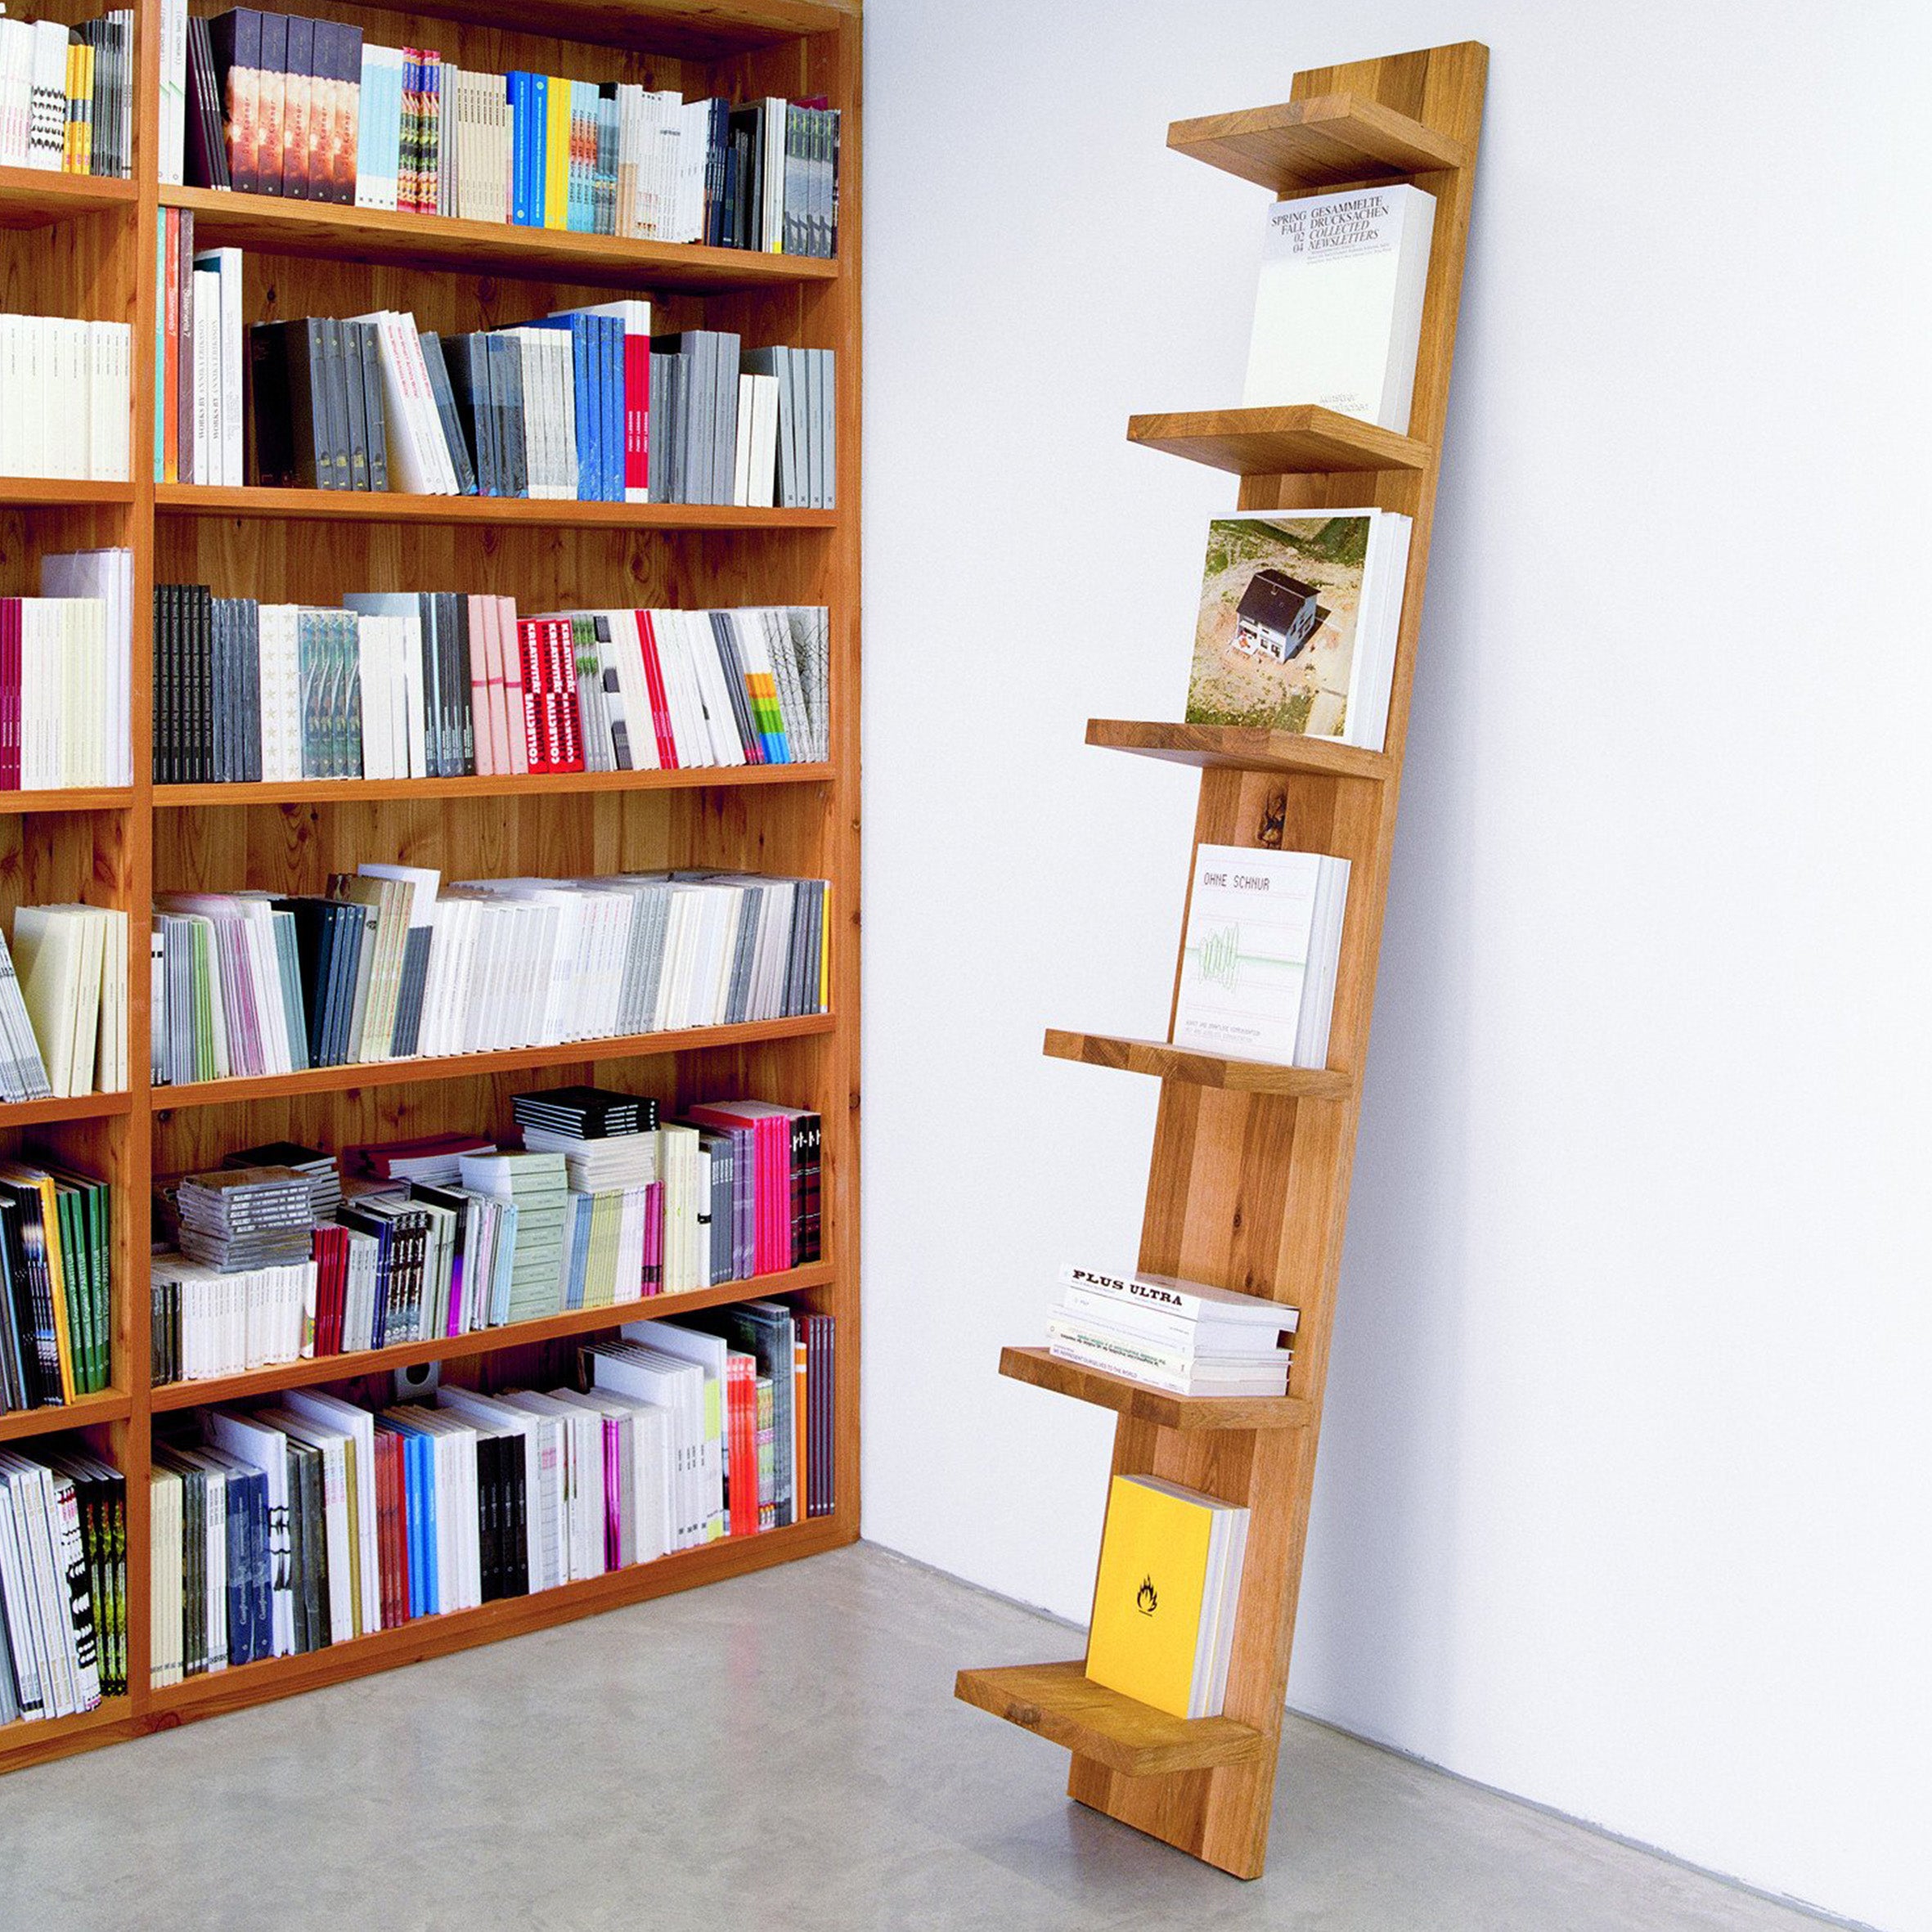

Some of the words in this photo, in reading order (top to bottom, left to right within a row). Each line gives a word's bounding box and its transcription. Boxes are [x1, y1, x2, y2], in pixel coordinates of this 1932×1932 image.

[1272, 211, 1306, 226] SPRING
[1311, 195, 1382, 218] GESAMMELTE
[1282, 221, 1305, 235] FALL
[1310, 206, 1390, 228] DRUCKSACHEN
[1293, 244, 1303, 253] 04
[1309, 229, 1379, 250] NEWSLETTERS
[1294, 231, 1305, 242] 02
[1310, 221, 1369, 240] COLLECTED
[528, 623, 541, 694] KREATIVITÄT
[549, 623, 563, 693] KREATIVITÄT
[562, 623, 575, 693] KREATIVITÄT
[525, 693, 538, 764] COLLECTIVE
[546, 693, 559, 764] COLLECTIVE
[1204, 872, 1227, 887] OHNE
[1233, 875, 1269, 890] SCHNUR
[66, 1253, 75, 1291] PARTITUR
[78, 1252, 87, 1290] PARTITUR
[1072, 1269, 1124, 1291] PLUS
[1130, 1285, 1183, 1306] ULTRA
